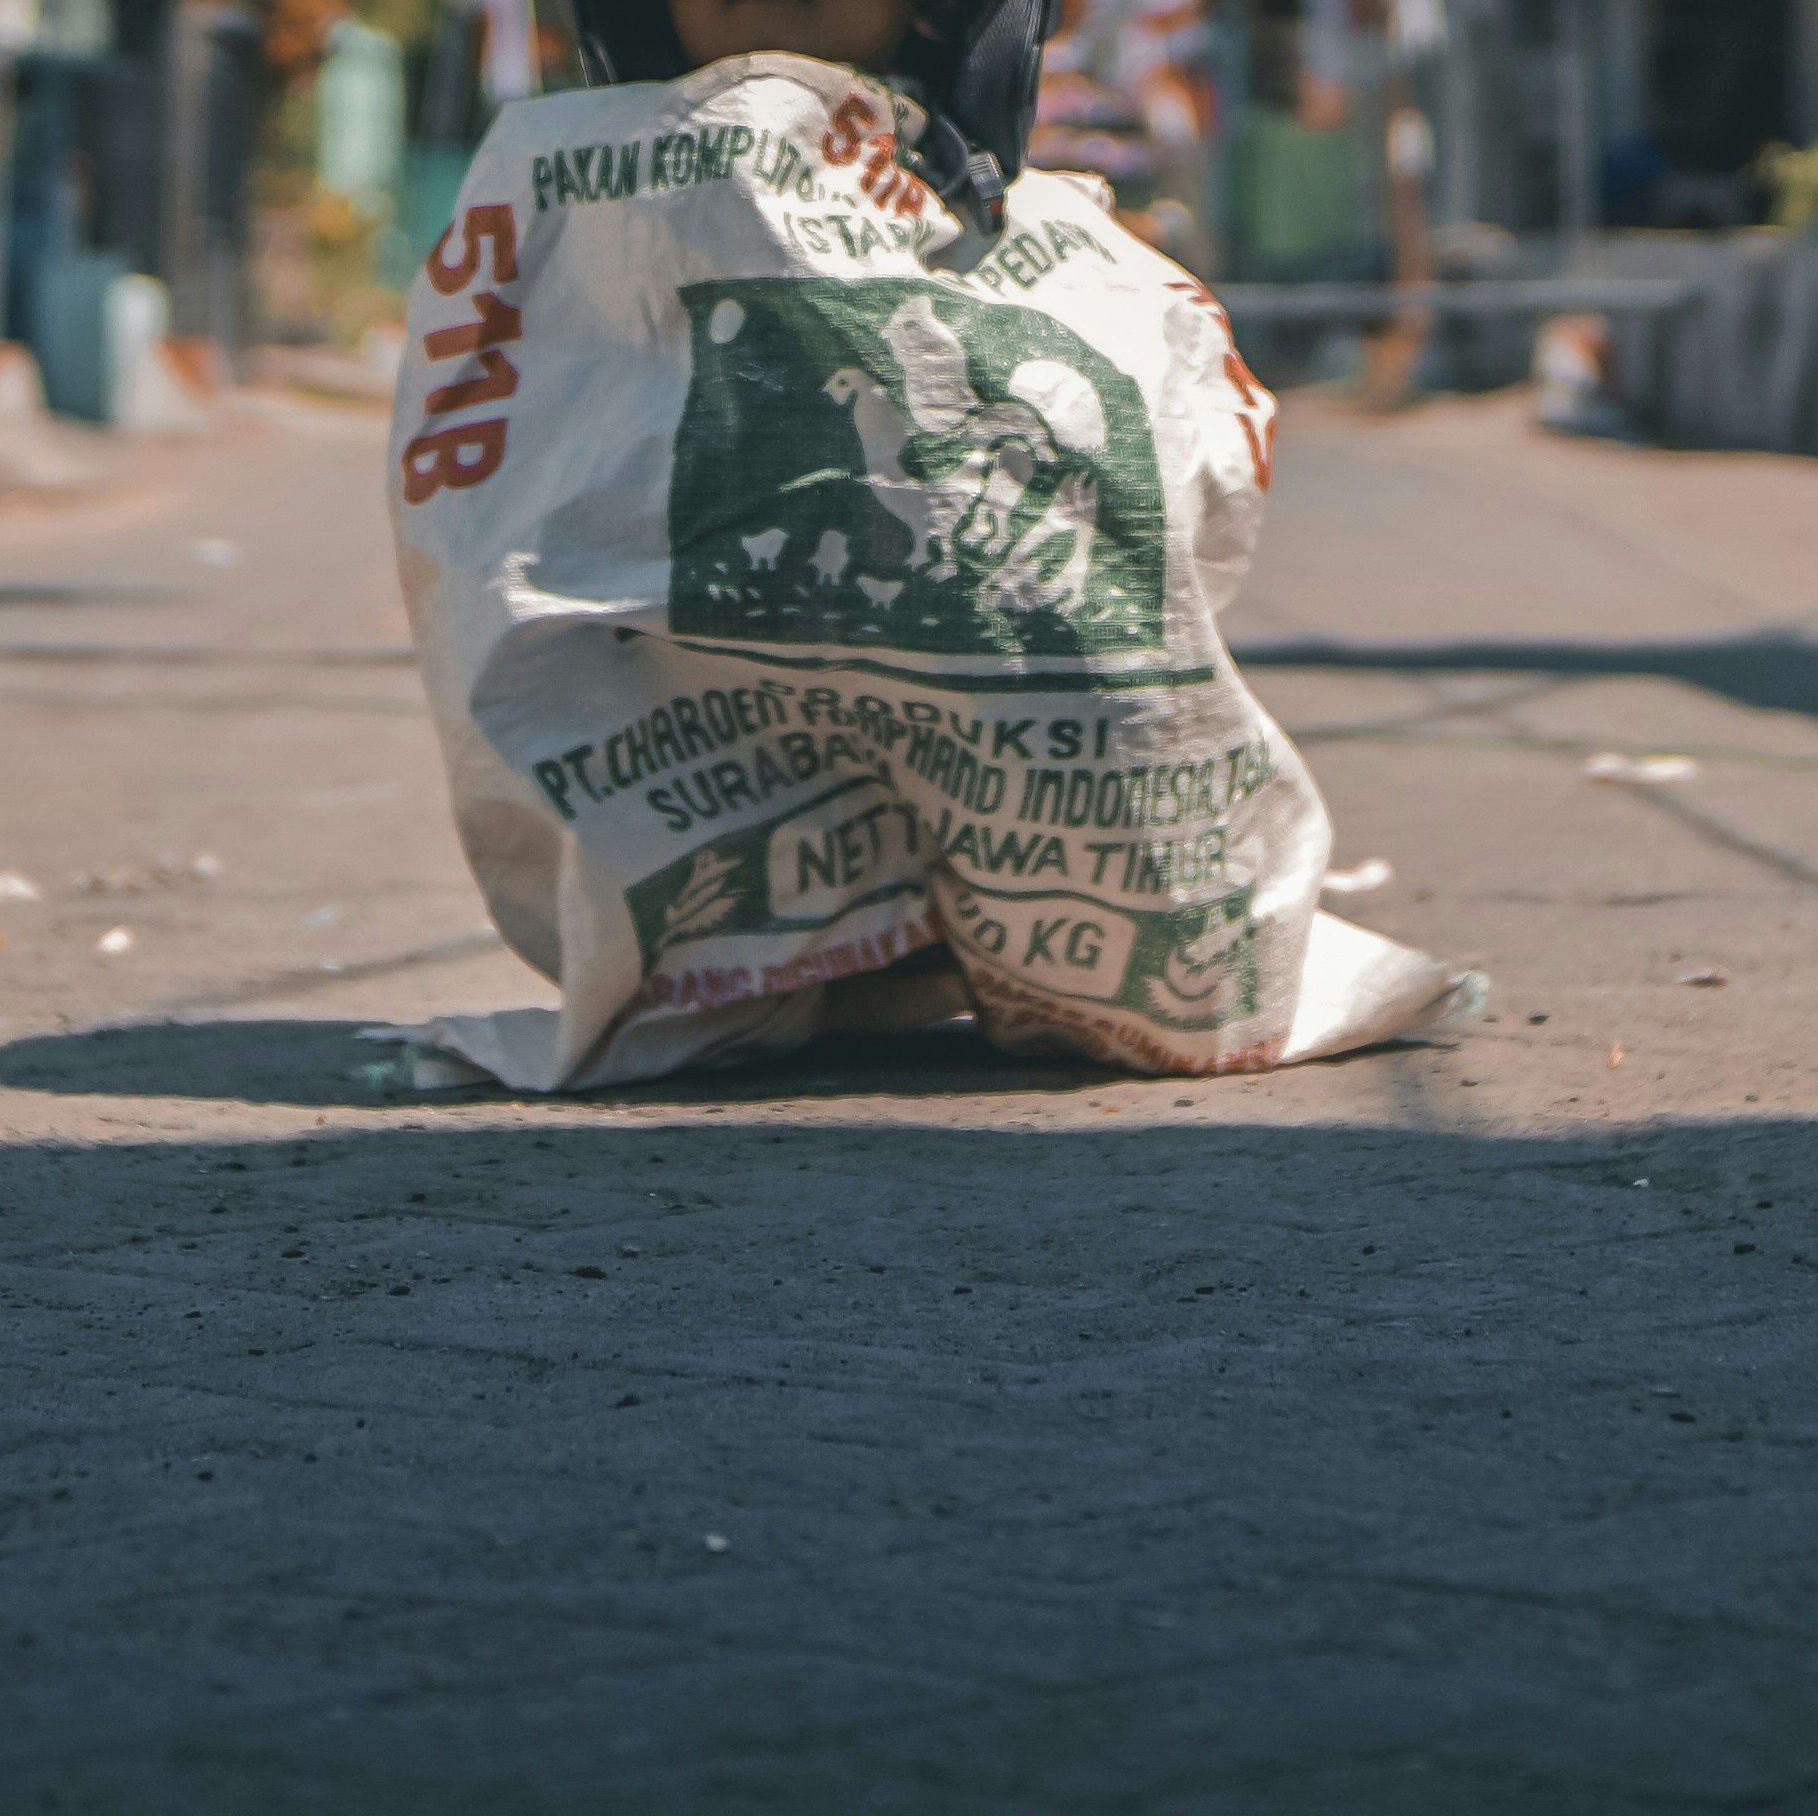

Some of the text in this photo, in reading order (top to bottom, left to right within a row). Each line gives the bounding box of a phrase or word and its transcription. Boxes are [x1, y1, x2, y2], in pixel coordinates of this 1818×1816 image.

[531, 141, 641, 212] PAKAN
[650, 124, 802, 195] KOMPLIT
[402, 203, 523, 506] 511B
[1084, 826, 1227, 894] TIMUR
[1022, 917, 1108, 970] KG
